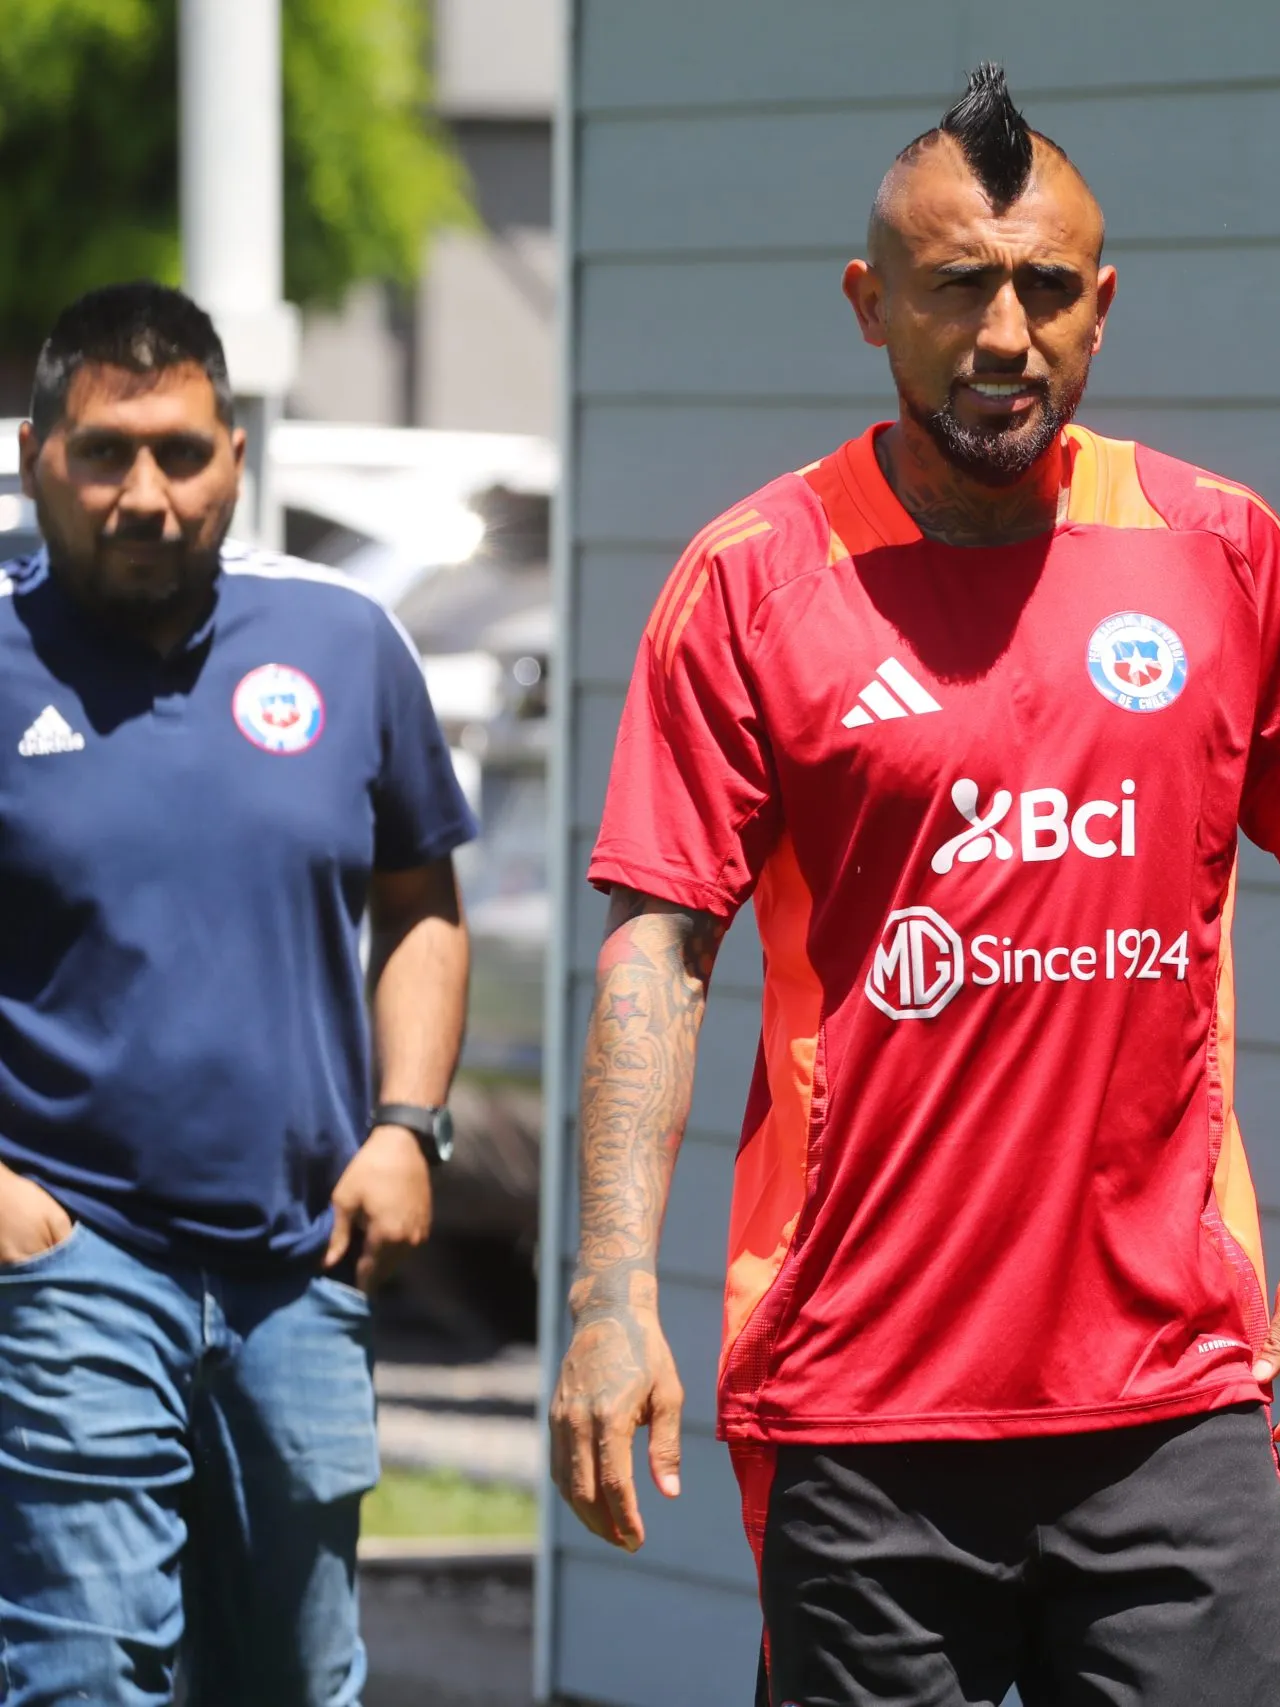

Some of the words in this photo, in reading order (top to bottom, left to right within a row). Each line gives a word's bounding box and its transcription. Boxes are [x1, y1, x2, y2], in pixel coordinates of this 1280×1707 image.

[1087, 613, 1138, 662] FEDACION
[1118, 693, 1133, 707] DE
[1138, 691, 1169, 709] CHILE
[1019, 778, 1136, 862] Bci
[870, 916, 955, 1009] MG
[970, 934, 1097, 985] Since
[1105, 927, 1190, 981] 1924
